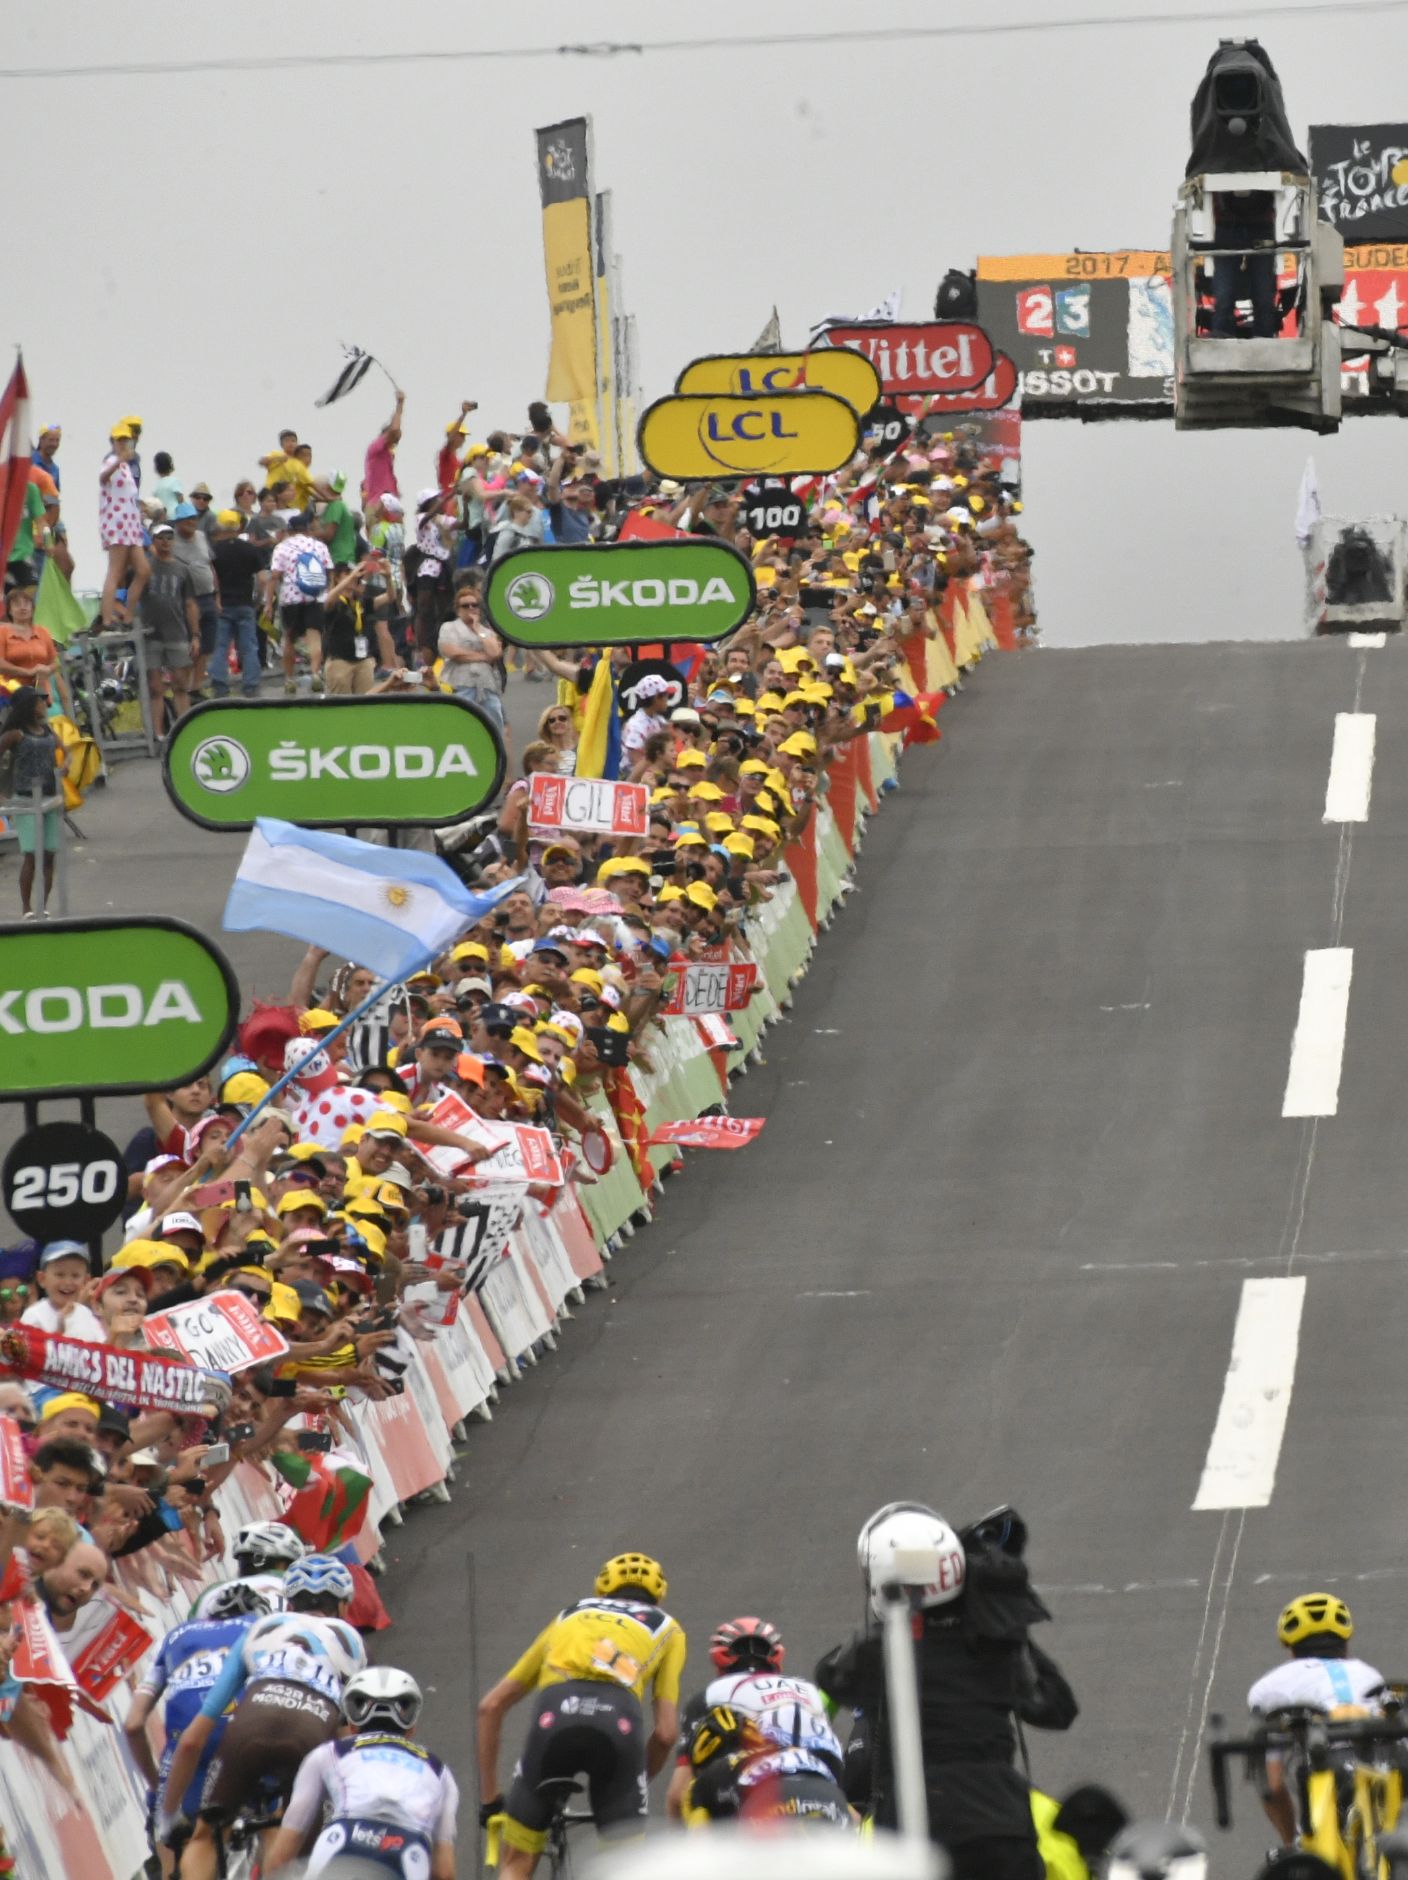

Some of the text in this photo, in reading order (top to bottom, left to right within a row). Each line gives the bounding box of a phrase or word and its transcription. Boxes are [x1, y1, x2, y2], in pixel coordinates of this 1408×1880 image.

[1066, 256, 1130, 275] 2017
[1018, 370, 1120, 396] ISSOT
[707, 411, 798, 442] LCL
[750, 504, 801, 531] 100
[569, 575, 736, 609] ŠKODA
[268, 740, 478, 782] ŠKODA
[566, 783, 611, 823] GIL
[0, 979, 203, 1035] KODA
[11, 1160, 118, 1212] 250
[185, 1313, 214, 1337] GO
[44, 1338, 102, 1383] AMICS
[105, 1354, 137, 1391] DEL
[251, 1692, 331, 1723] MONDIALE
